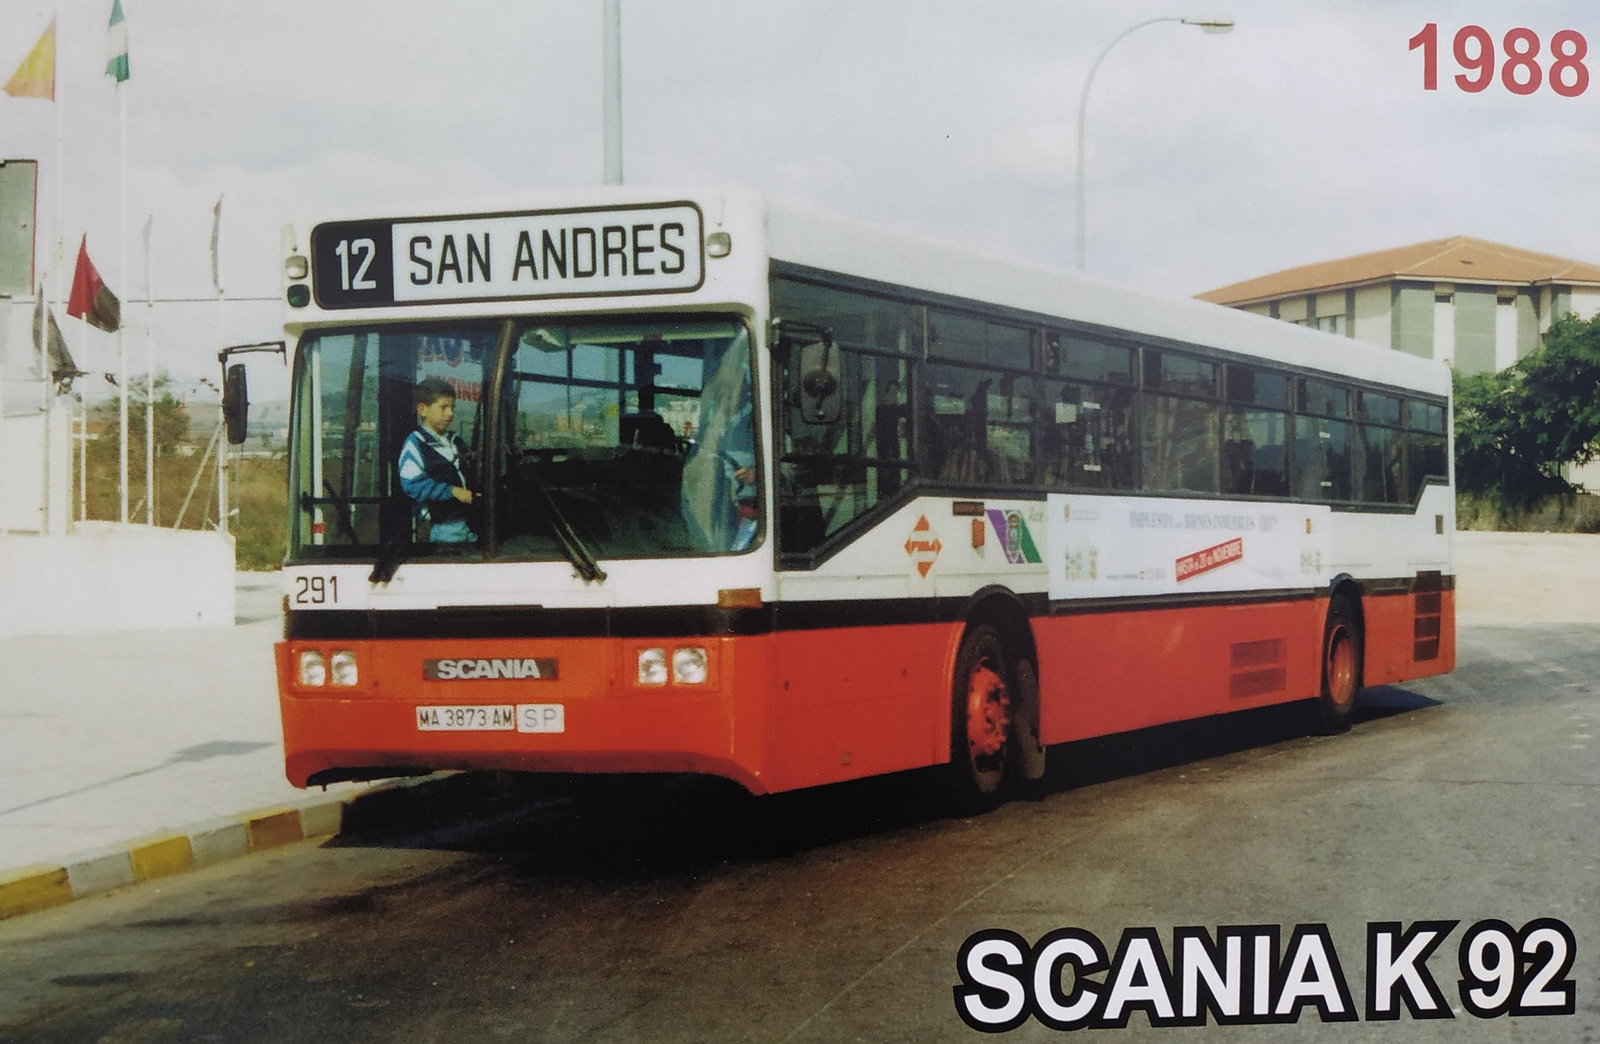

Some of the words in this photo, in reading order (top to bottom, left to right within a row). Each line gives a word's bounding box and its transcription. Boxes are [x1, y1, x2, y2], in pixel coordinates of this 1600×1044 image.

[334, 237, 377, 291] 12
[408, 232, 492, 286] SAN
[511, 221, 686, 283] ANDRES
[295, 576, 339, 605] 291
[436, 658, 541, 680] SCANIA
[419, 709, 440, 728] MA
[446, 708, 487, 728] 3873
[492, 708, 514, 728] AM
